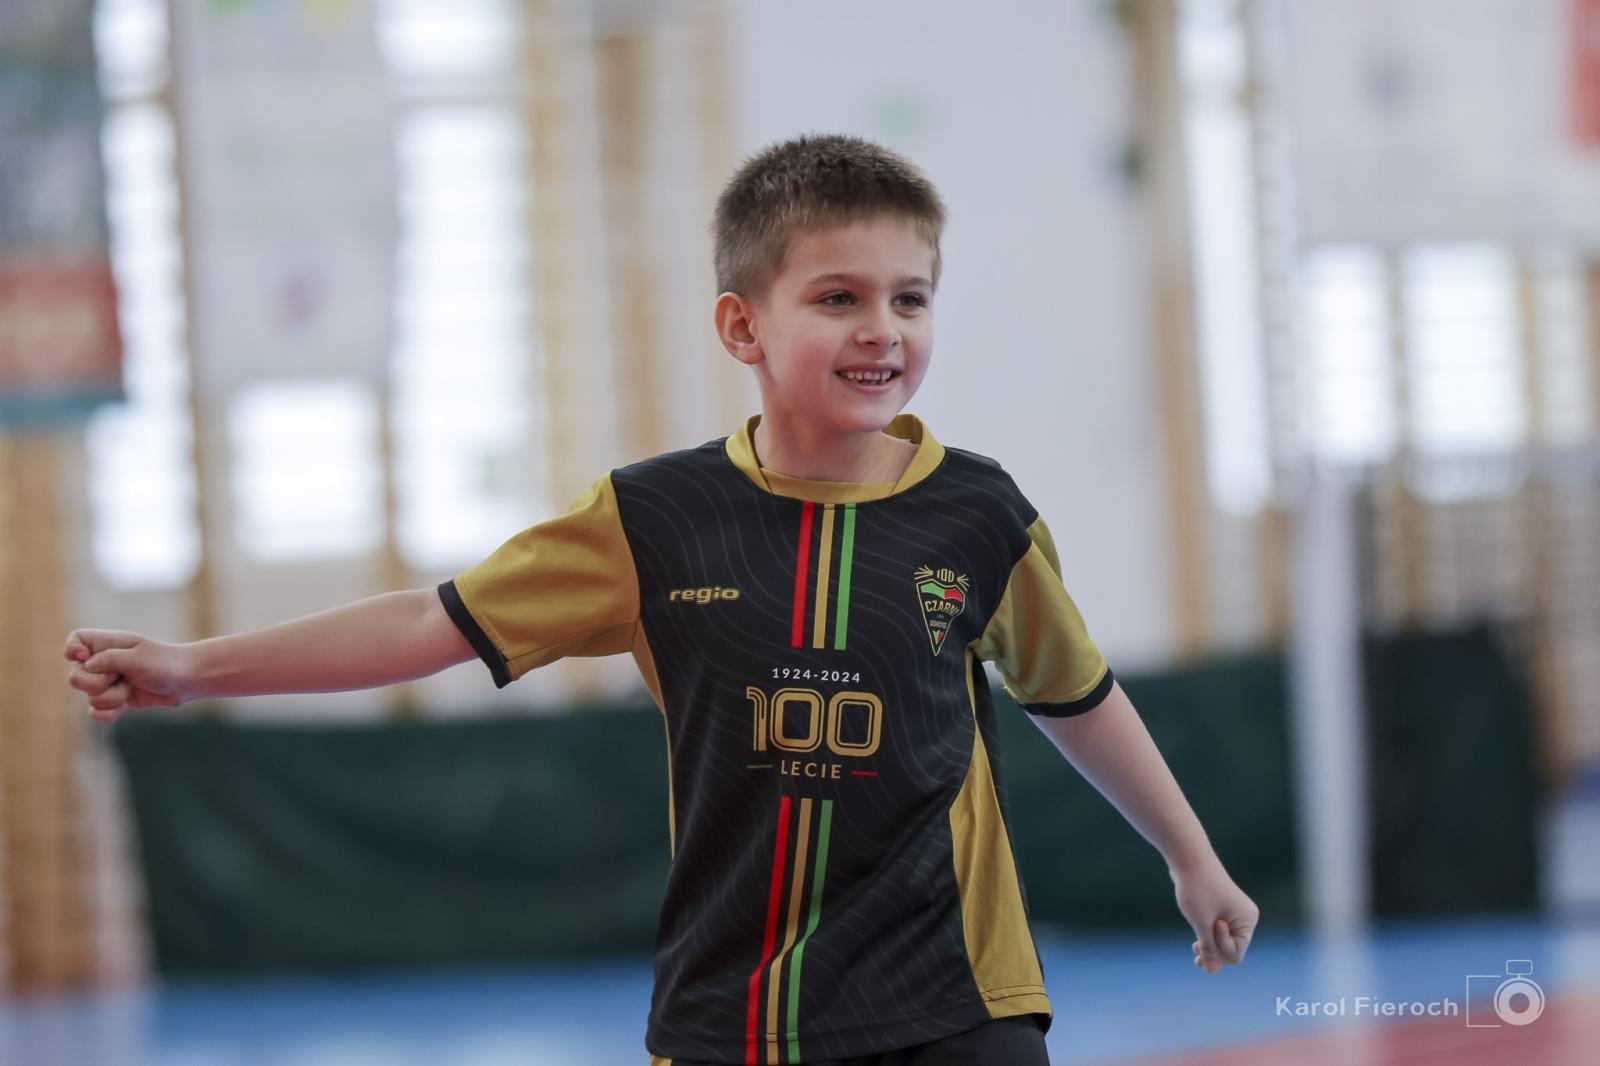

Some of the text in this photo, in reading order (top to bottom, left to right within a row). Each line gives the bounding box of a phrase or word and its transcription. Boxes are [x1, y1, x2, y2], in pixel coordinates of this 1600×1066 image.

[669, 585, 741, 605] regio
[924, 600, 960, 617] CZARNI
[771, 667, 861, 684] 1924-2024
[746, 686, 883, 757] 100
[780, 759, 843, 779] LECIE
